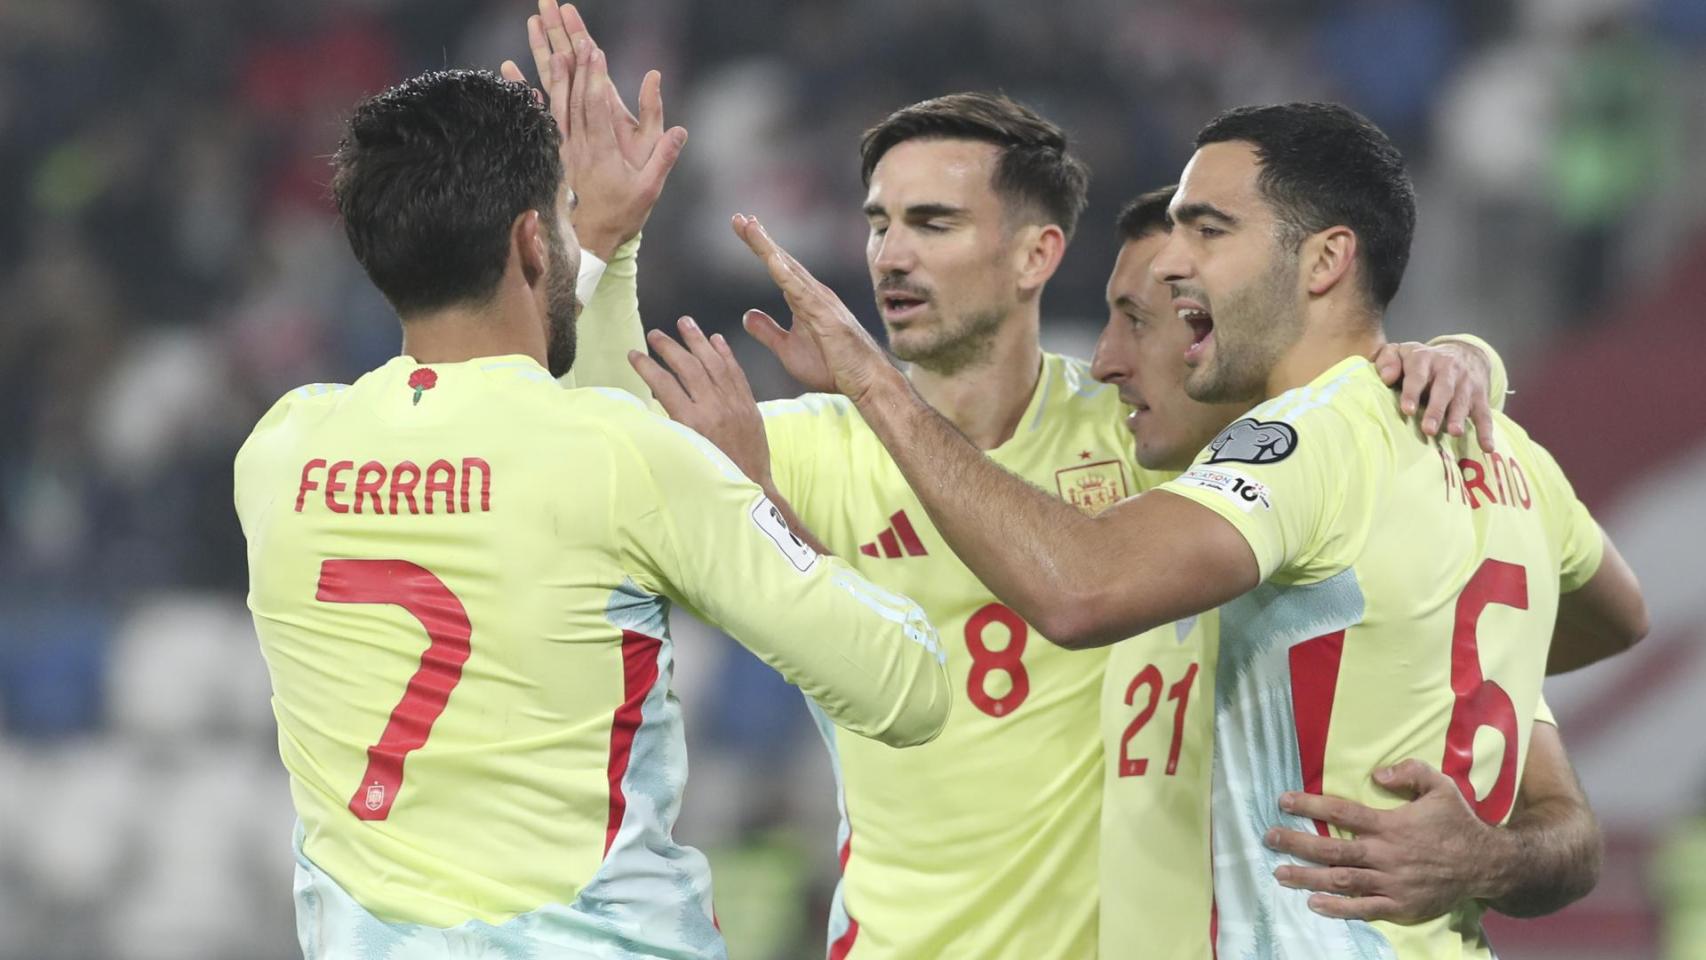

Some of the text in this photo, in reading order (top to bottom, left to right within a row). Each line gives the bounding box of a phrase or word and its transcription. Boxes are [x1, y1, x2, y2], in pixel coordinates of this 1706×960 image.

[294, 457, 491, 515] FERRAN
[316, 559, 472, 822] 7
[964, 602, 1030, 718] 8
[1442, 557, 1529, 826] 6
[1118, 662, 1200, 778] 21
